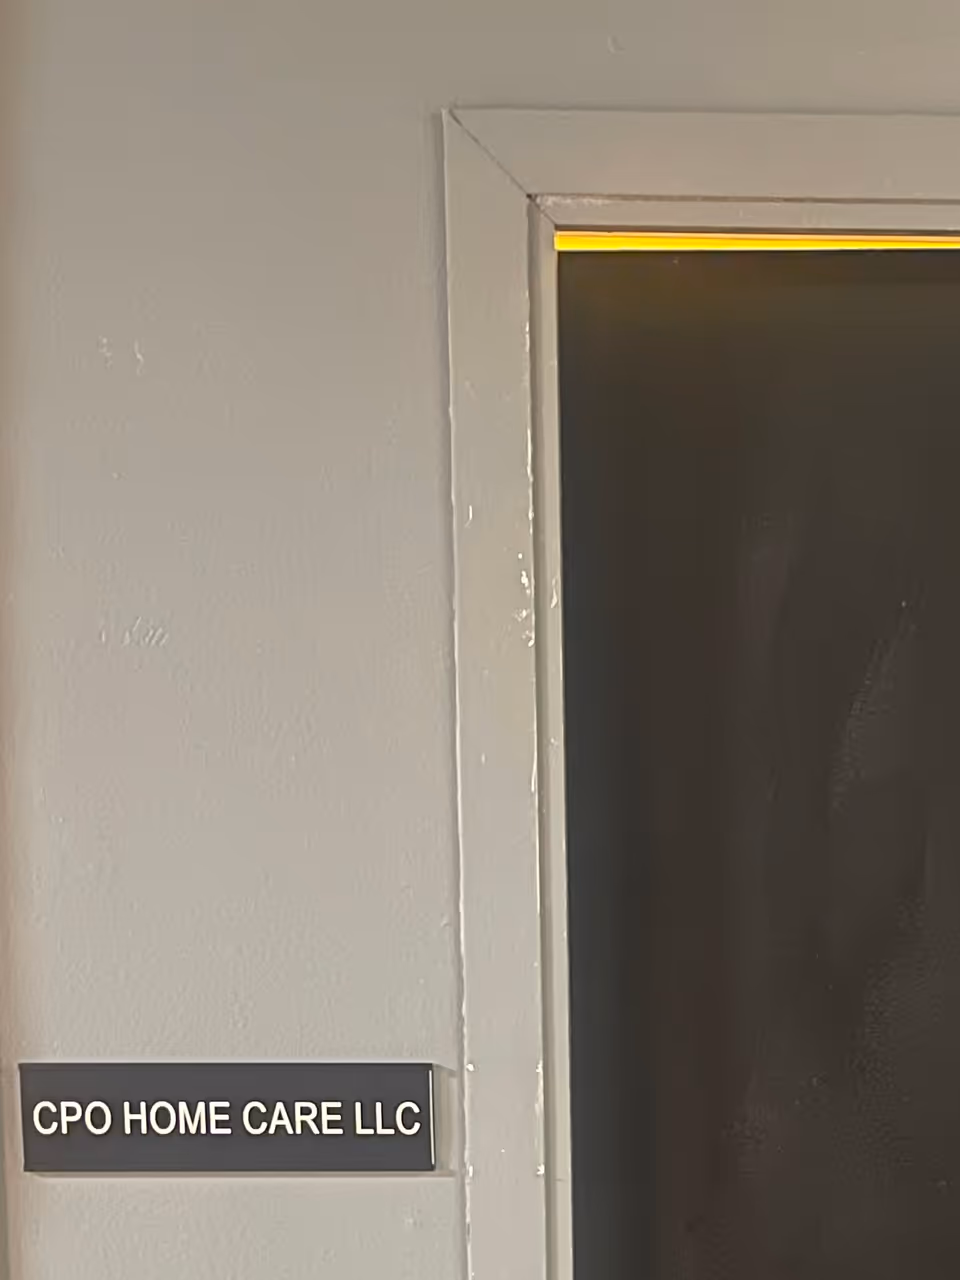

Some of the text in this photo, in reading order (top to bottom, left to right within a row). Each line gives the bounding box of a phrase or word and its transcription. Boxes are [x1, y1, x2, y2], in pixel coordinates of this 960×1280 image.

[33, 1101, 420, 1135] CPO HOME CARE LLC
